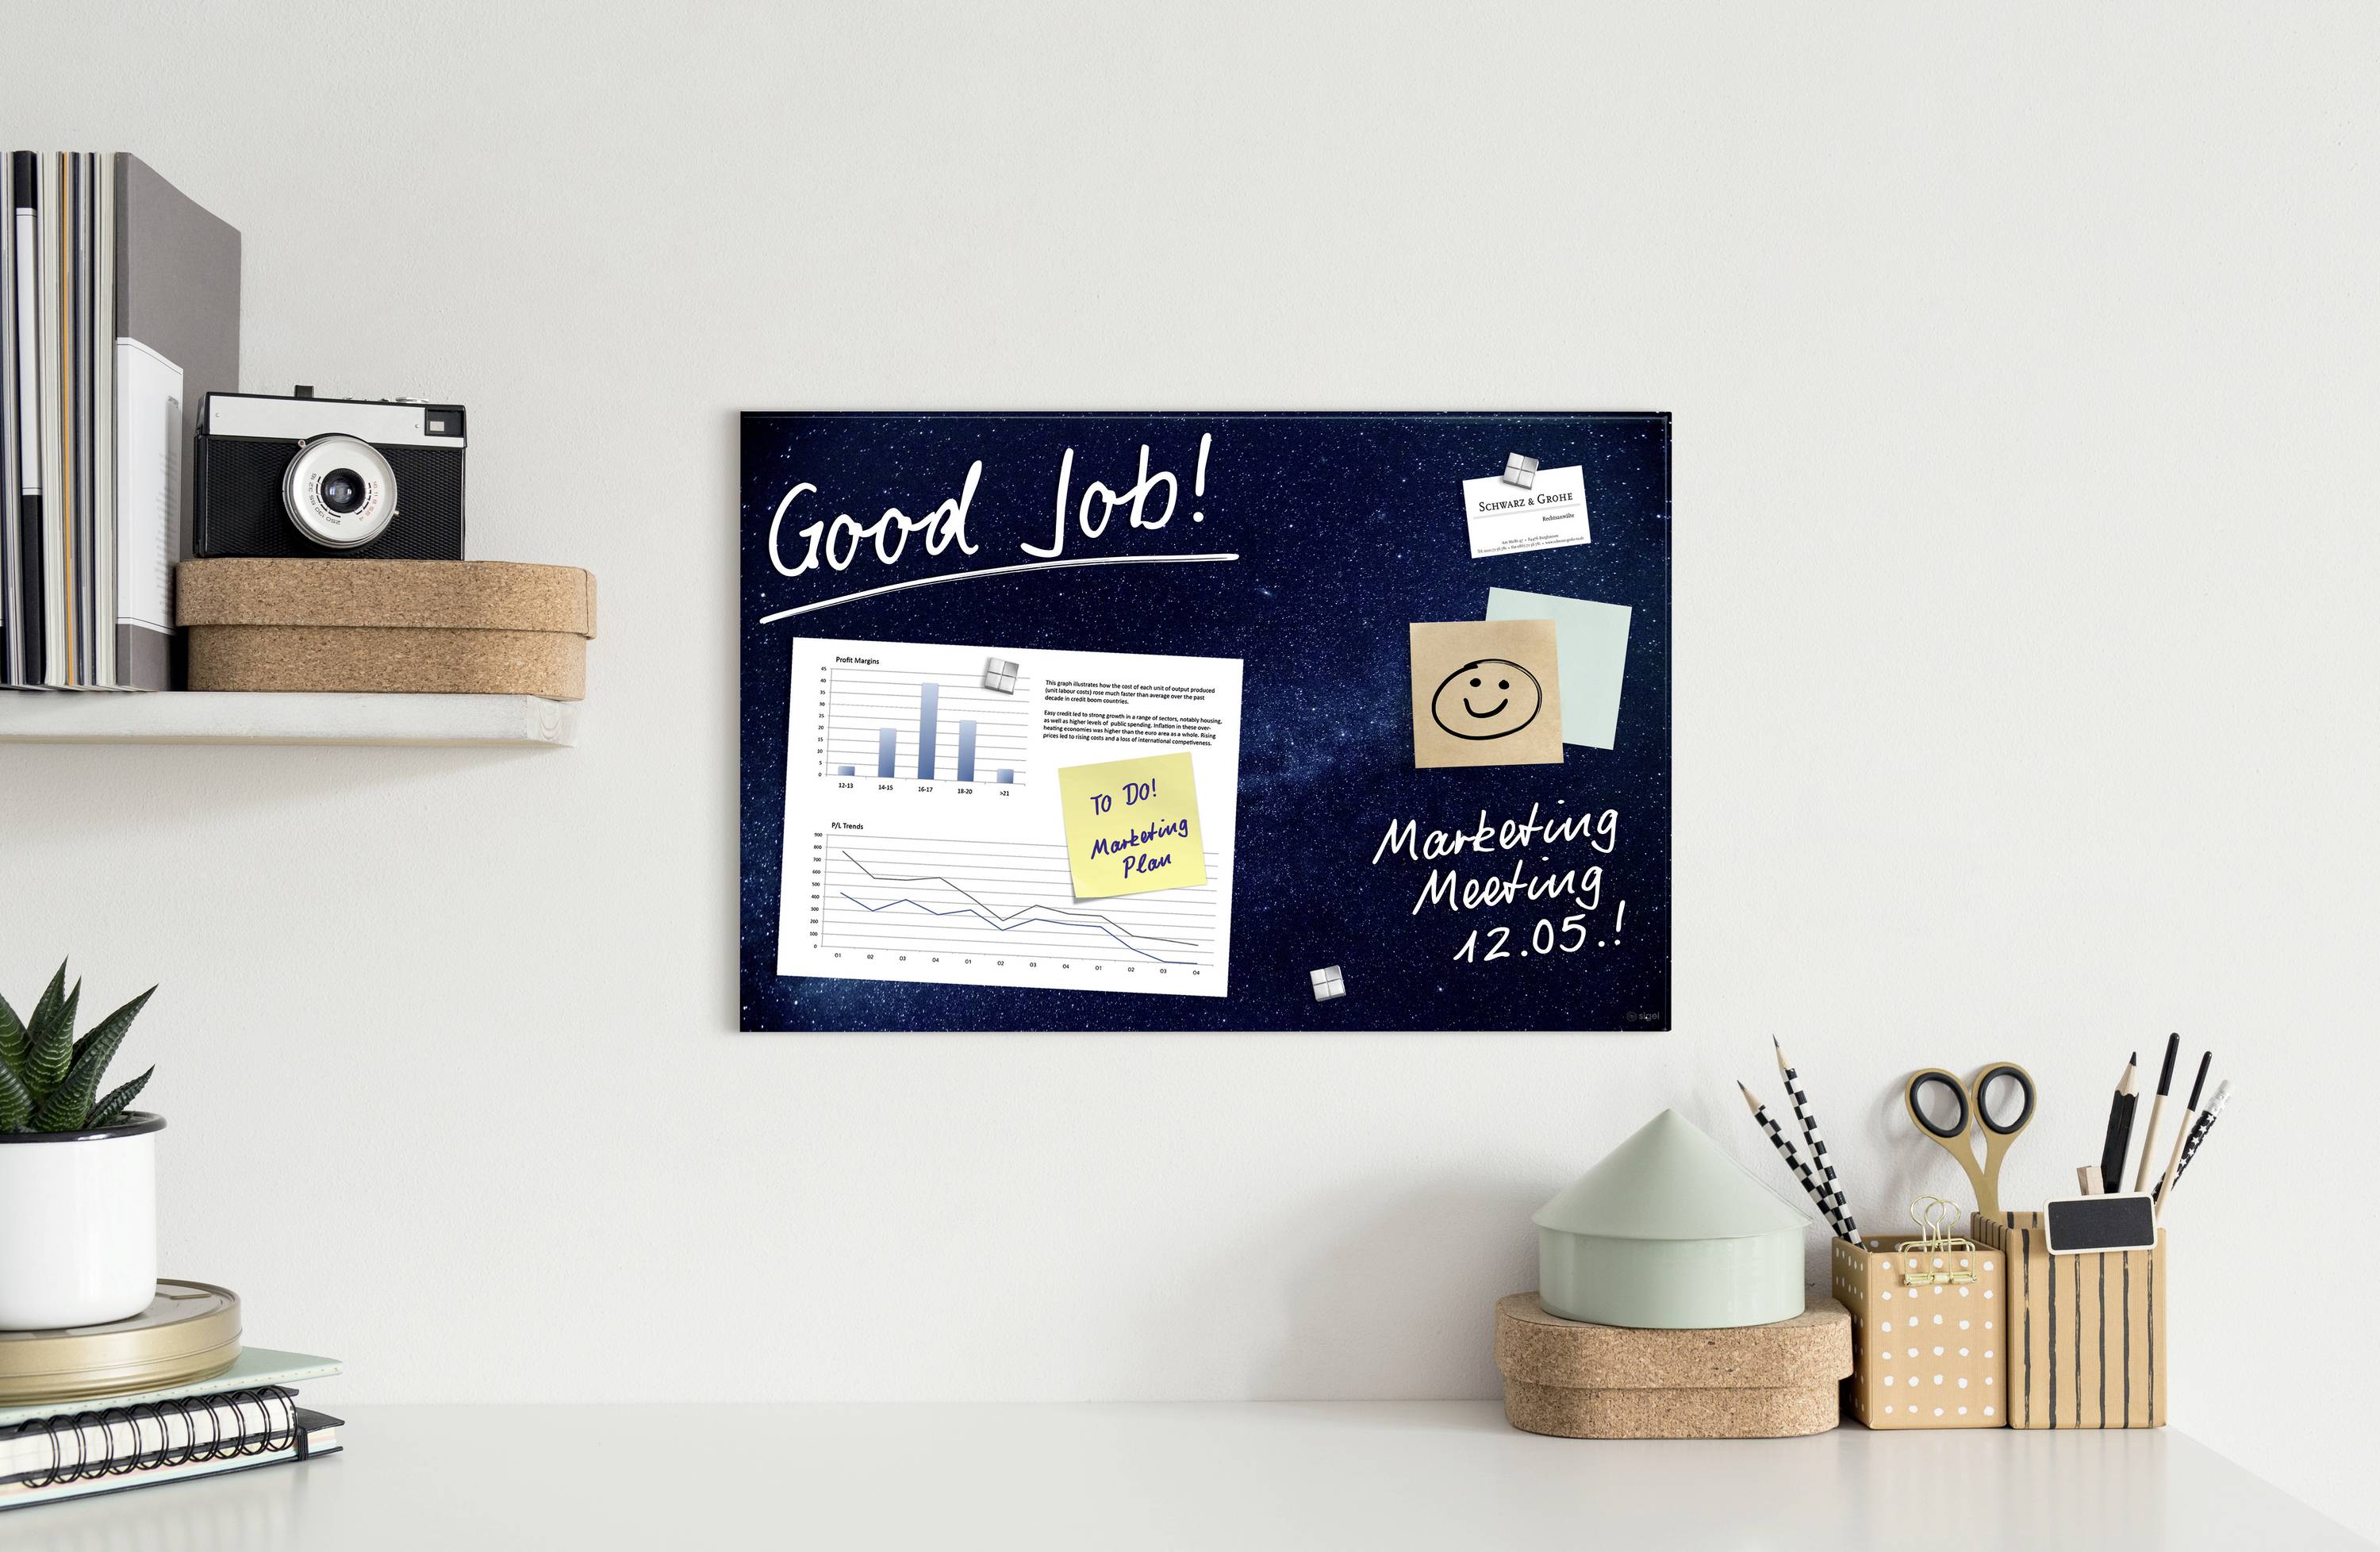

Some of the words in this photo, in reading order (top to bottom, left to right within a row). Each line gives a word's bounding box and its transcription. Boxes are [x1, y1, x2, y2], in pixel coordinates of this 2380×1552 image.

[769, 460, 982, 577] Good
[1021, 433, 1211, 557] Job!
[1479, 498, 1526, 513] SCHWARZ
[1528, 497, 1535, 506] &
[1537, 492, 1573, 505] GROHE
[854, 657, 880, 666] Margins
[1091, 794, 1111, 815] TO
[1123, 778, 1156, 805] DO!
[1091, 819, 1188, 859] Marketing
[1372, 800, 1618, 864] Marketing
[1123, 854, 1171, 878] Plan
[1412, 856, 1603, 915] Meeting
[1453, 899, 1626, 962] 12.05.!
[1638, 1012, 1660, 1021] sigel
